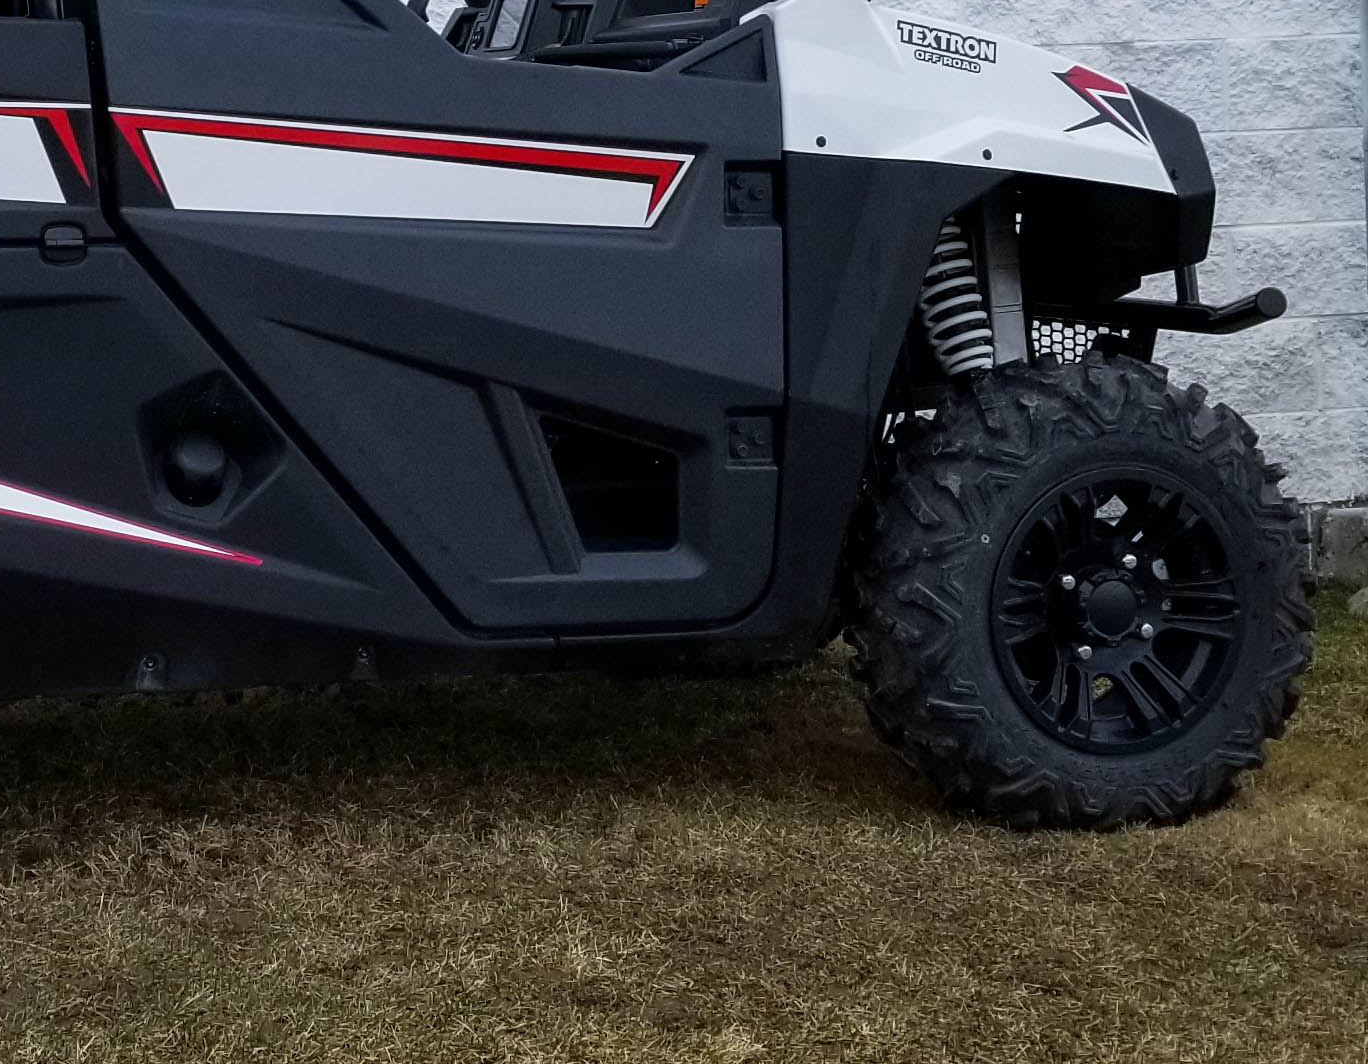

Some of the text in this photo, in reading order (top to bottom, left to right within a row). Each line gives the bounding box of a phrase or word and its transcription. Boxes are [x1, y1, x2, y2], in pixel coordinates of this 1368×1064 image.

[897, 21, 996, 63] TEXTRON
[914, 49, 981, 73] OFF ROAD
